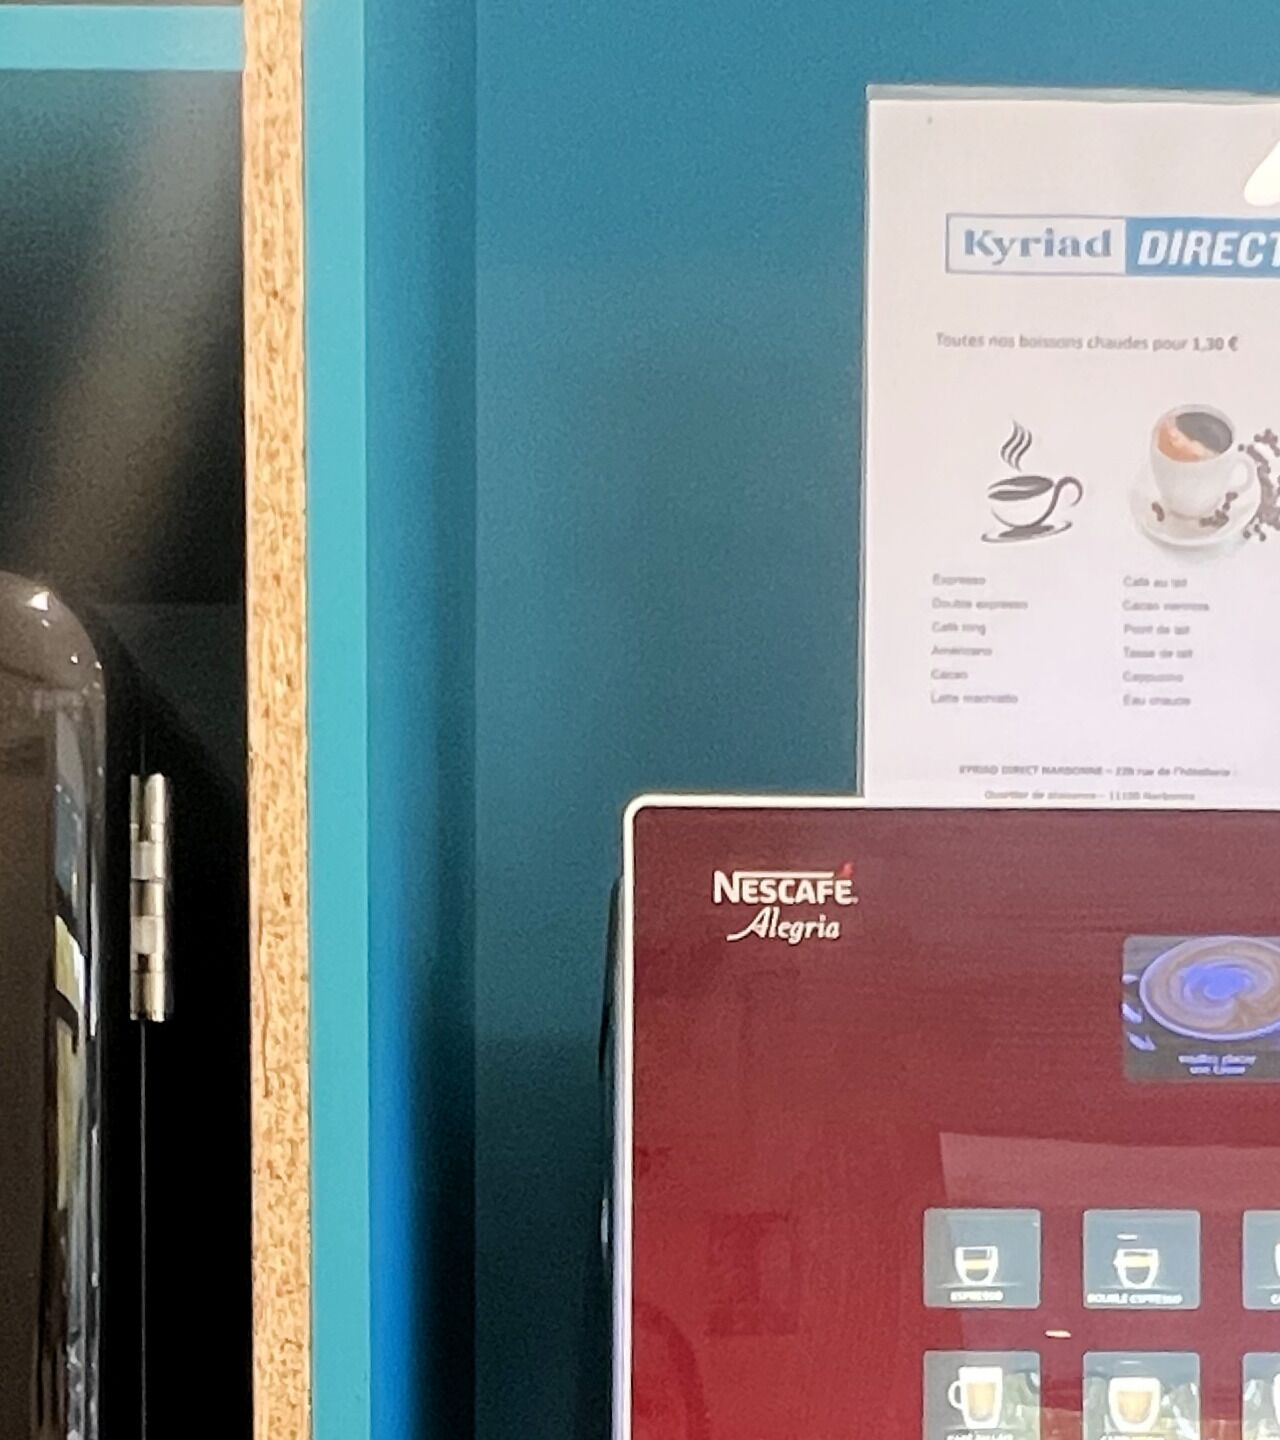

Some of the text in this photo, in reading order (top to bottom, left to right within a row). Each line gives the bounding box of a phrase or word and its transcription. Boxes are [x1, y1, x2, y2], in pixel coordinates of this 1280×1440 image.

[964, 228, 1111, 265] Kyriad
[936, 331, 985, 348] Toutes
[988, 336, 1015, 348] nos
[1019, 333, 1083, 349] boissons
[1087, 335, 1148, 350] chaudes
[1152, 338, 1188, 352] pour
[713, 863, 854, 905] NESCAFÉ
[726, 906, 841, 945] Alegria
